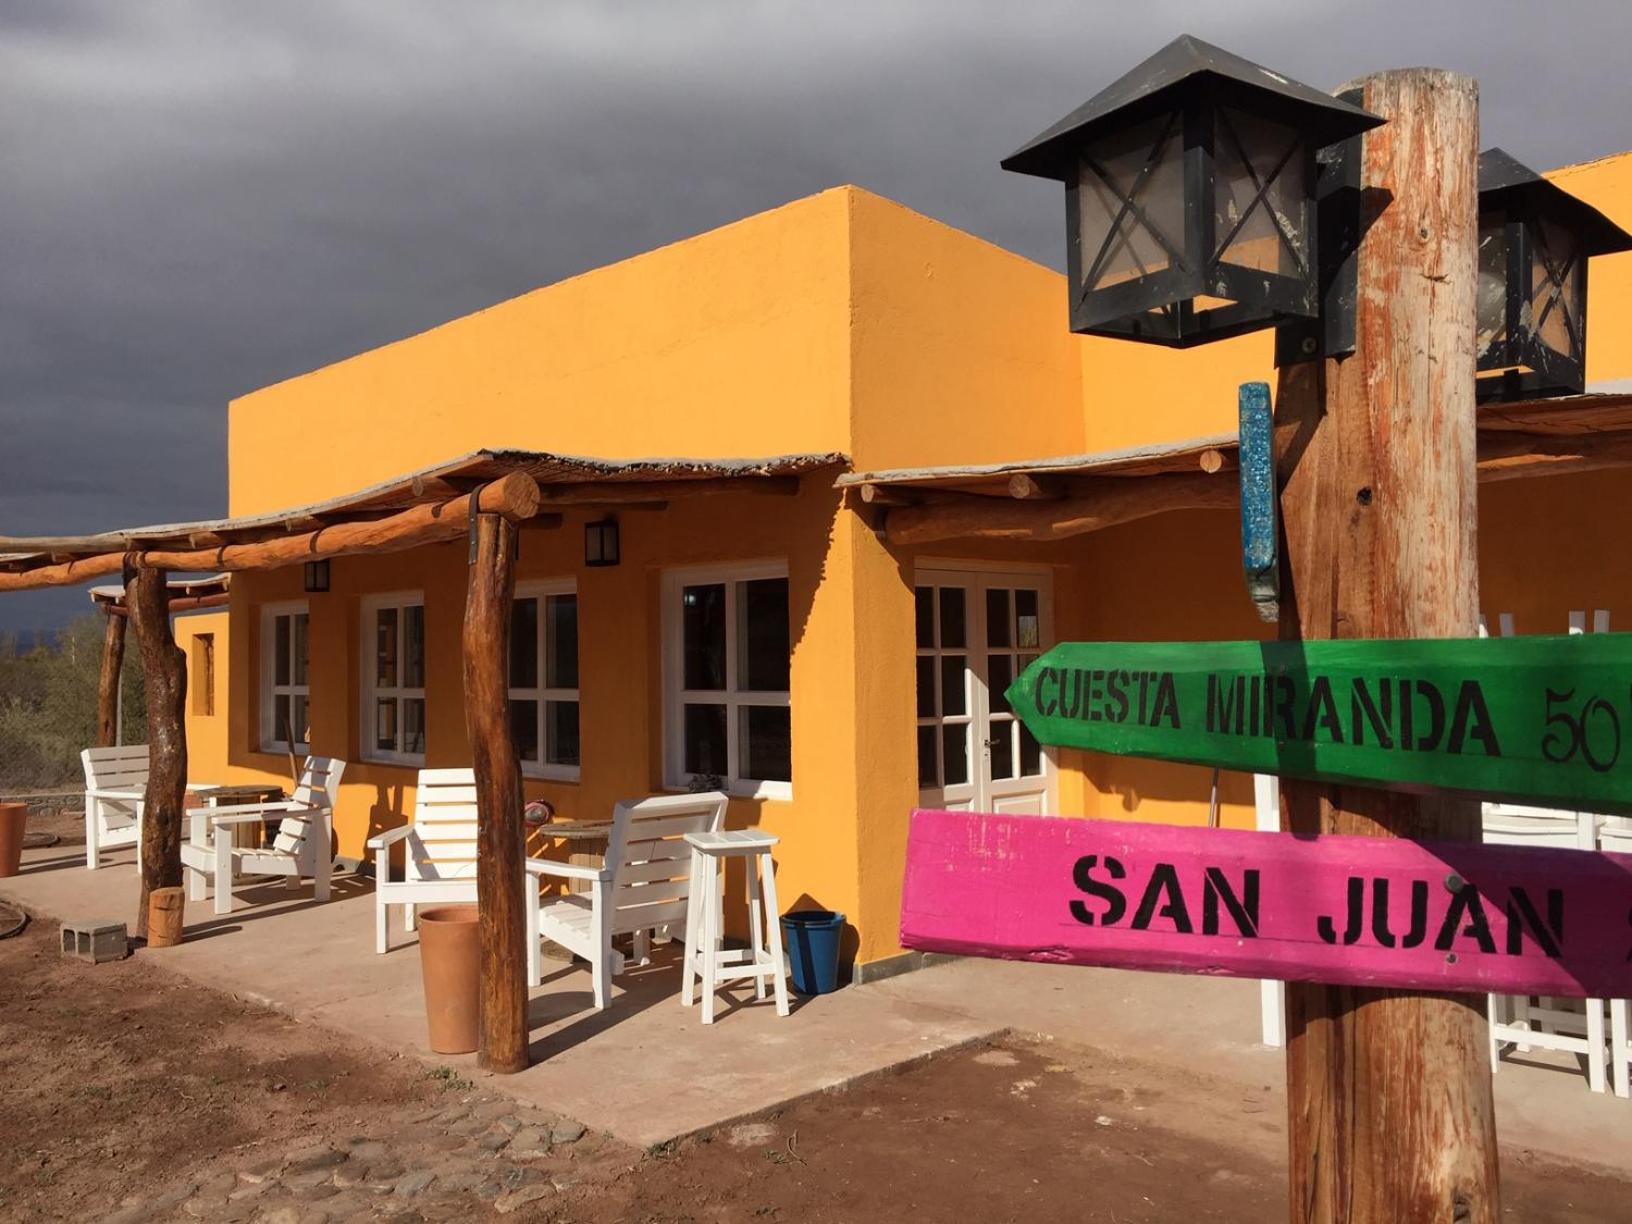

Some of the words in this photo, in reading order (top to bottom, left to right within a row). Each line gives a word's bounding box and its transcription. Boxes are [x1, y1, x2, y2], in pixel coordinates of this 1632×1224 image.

[1034, 667, 1181, 729] CUESTA
[1207, 673, 1501, 757] MIRANDA
[1069, 855, 1260, 938] SAN
[1317, 877, 1563, 959] JUAN
